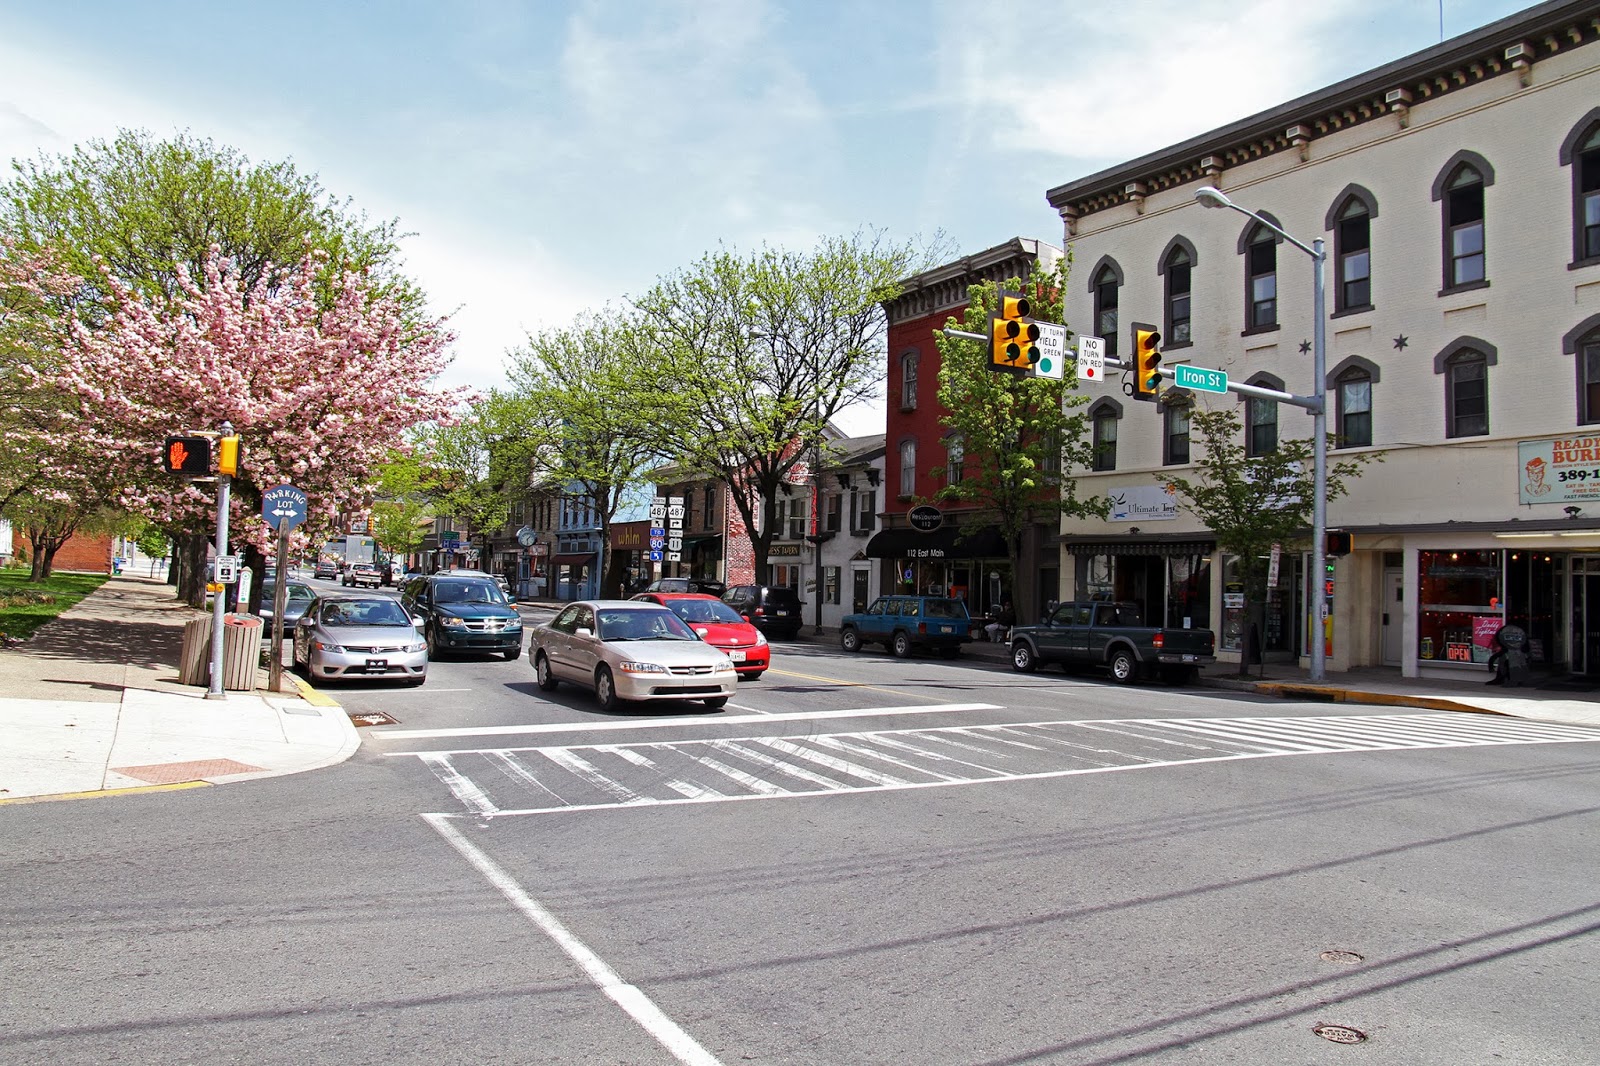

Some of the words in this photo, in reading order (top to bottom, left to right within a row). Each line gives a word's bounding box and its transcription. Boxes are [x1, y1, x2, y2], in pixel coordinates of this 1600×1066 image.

[1049, 328, 1064, 337] TURN
[1039, 337, 1058, 347] YIELD
[1085, 340, 1098, 349] NO
[1043, 348, 1061, 357] GREEN
[1083, 349, 1099, 358] TURN
[1079, 358, 1088, 366] ON
[1090, 359, 1103, 368] RED
[1183, 369, 1206, 385] Iron
[1208, 373, 1221, 387] St
[265, 489, 306, 505] PARKING
[277, 501, 294, 509] LOT
[1128, 503, 1160, 513] Ultimate
[651, 508, 666, 516] 487
[669, 508, 684, 516] 487
[618, 526, 640, 545] whlm
[651, 540, 663, 548] 80
[672, 540, 679, 549] 11
[907, 549, 916, 557] 112
[918, 549, 929, 557] East
[930, 549, 944, 557] Main
[1449, 648, 1469, 660] OPEN
